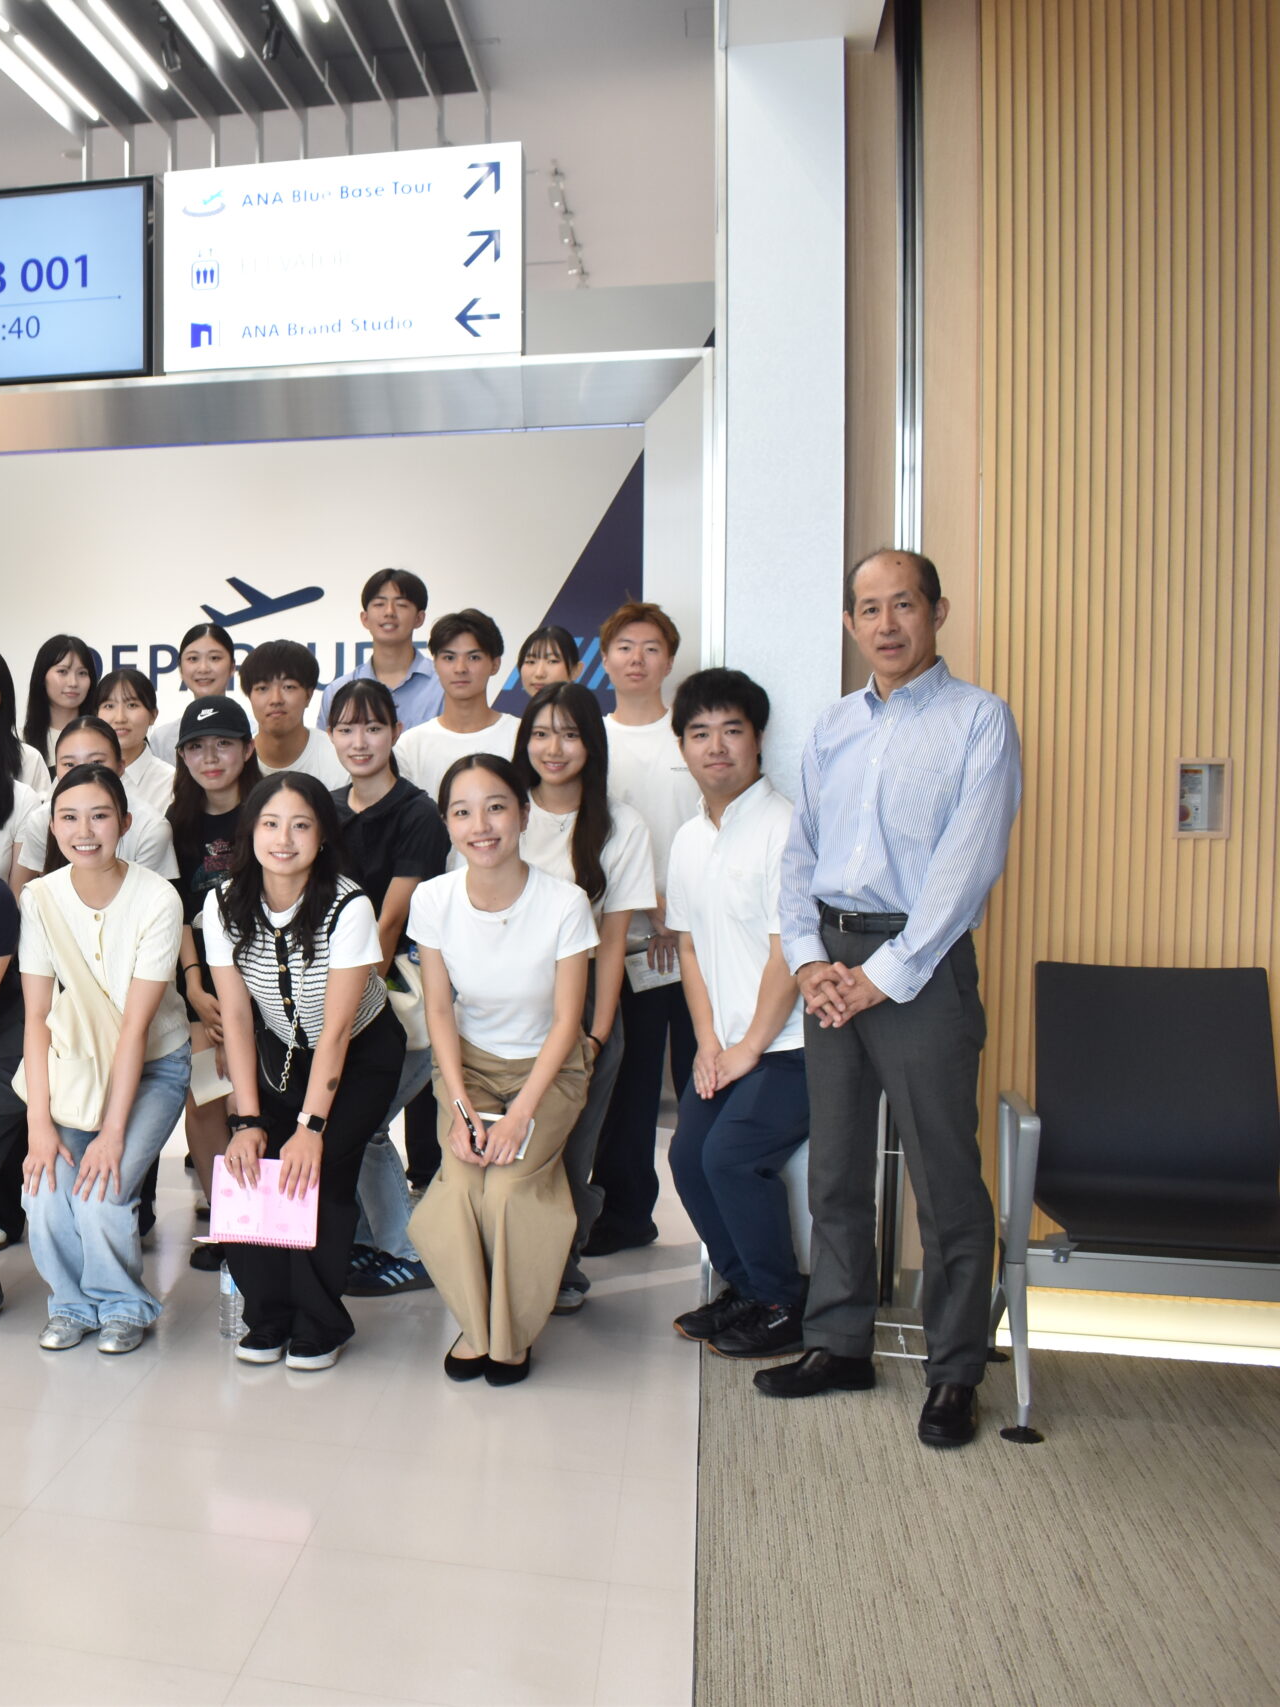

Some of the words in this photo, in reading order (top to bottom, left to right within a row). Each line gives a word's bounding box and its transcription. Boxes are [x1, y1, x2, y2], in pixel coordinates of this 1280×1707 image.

[241, 192, 283, 207] ANA
[339, 185, 385, 199] Base
[392, 181, 433, 195] Tour
[20, 254, 88, 293] 001
[241, 323, 280, 339] ANA
[287, 318, 342, 336] Brand
[350, 315, 413, 332] Studio
